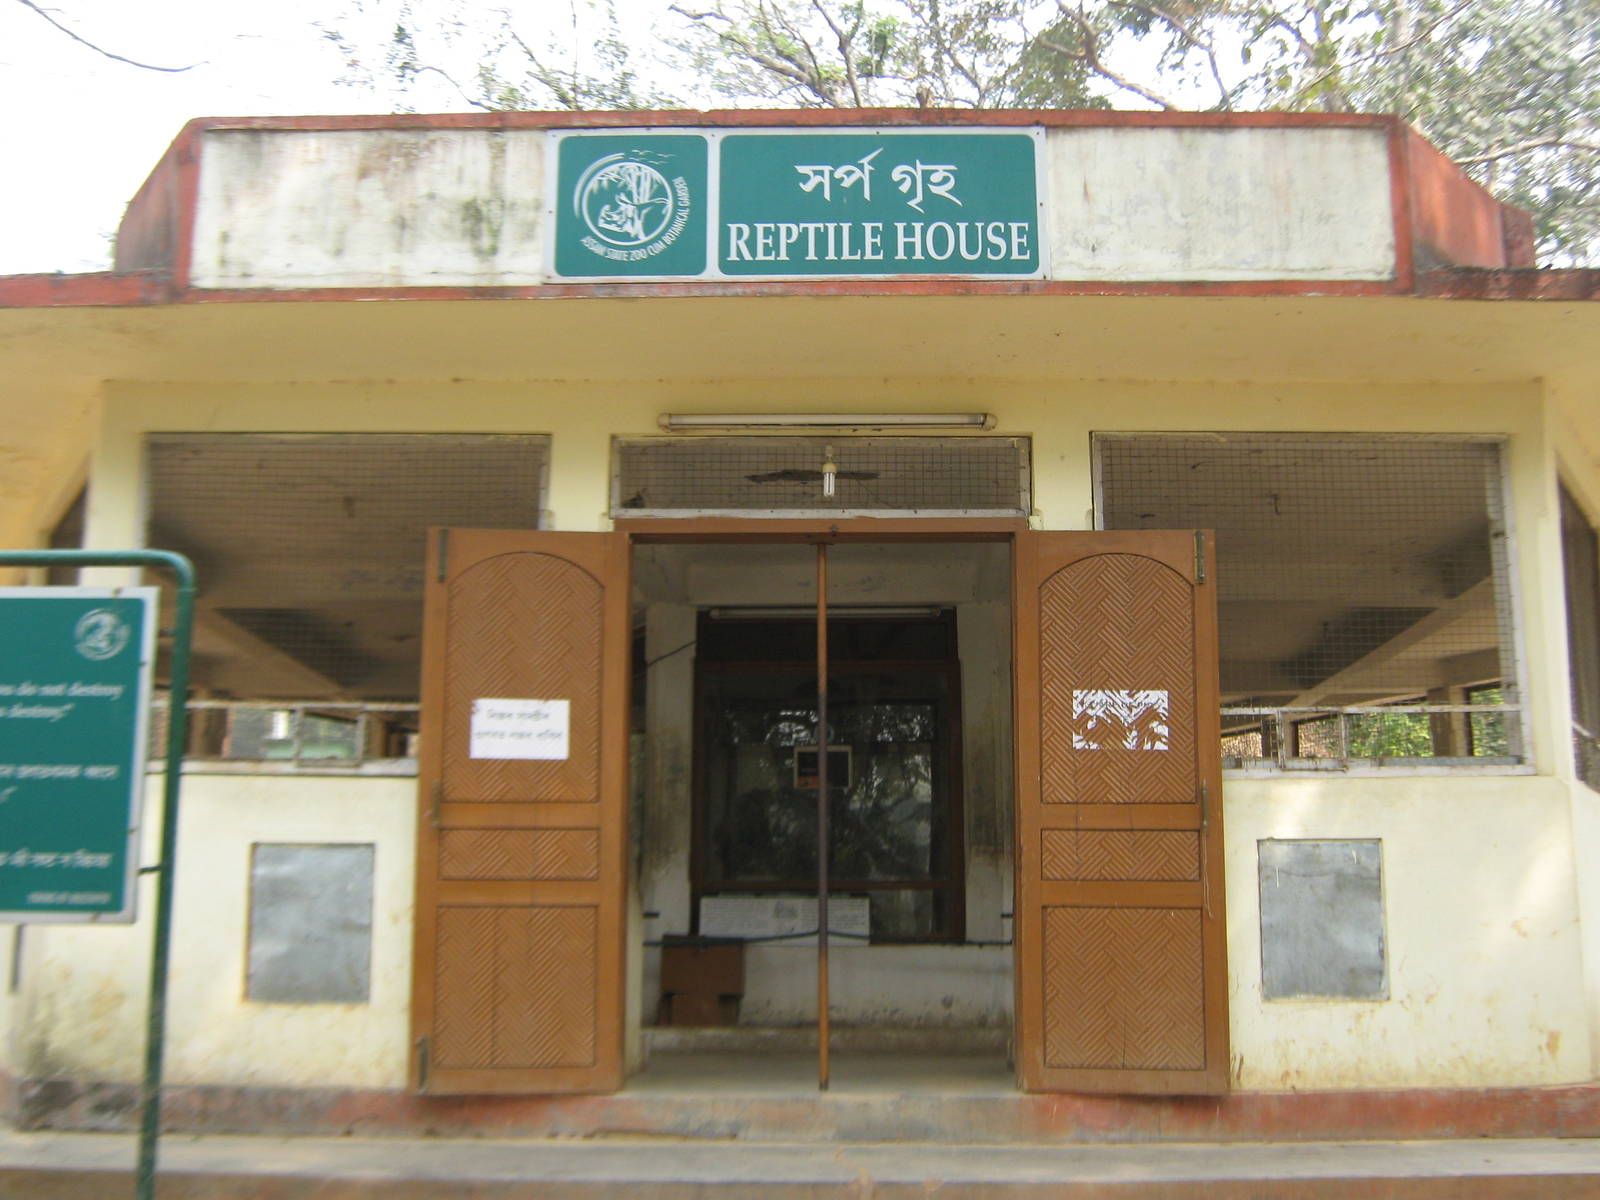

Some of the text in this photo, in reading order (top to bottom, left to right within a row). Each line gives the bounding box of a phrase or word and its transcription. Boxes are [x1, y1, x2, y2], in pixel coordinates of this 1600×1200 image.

[672, 176, 691, 206] GARDEN
[891, 159, 963, 214] গৃহ
[663, 208, 691, 246] BOTANICAL
[726, 221, 1031, 261] REPTILE HOUSE
[605, 247, 629, 262] STATE
[628, 249, 648, 261] ZOO
[648, 241, 667, 257] CUM
